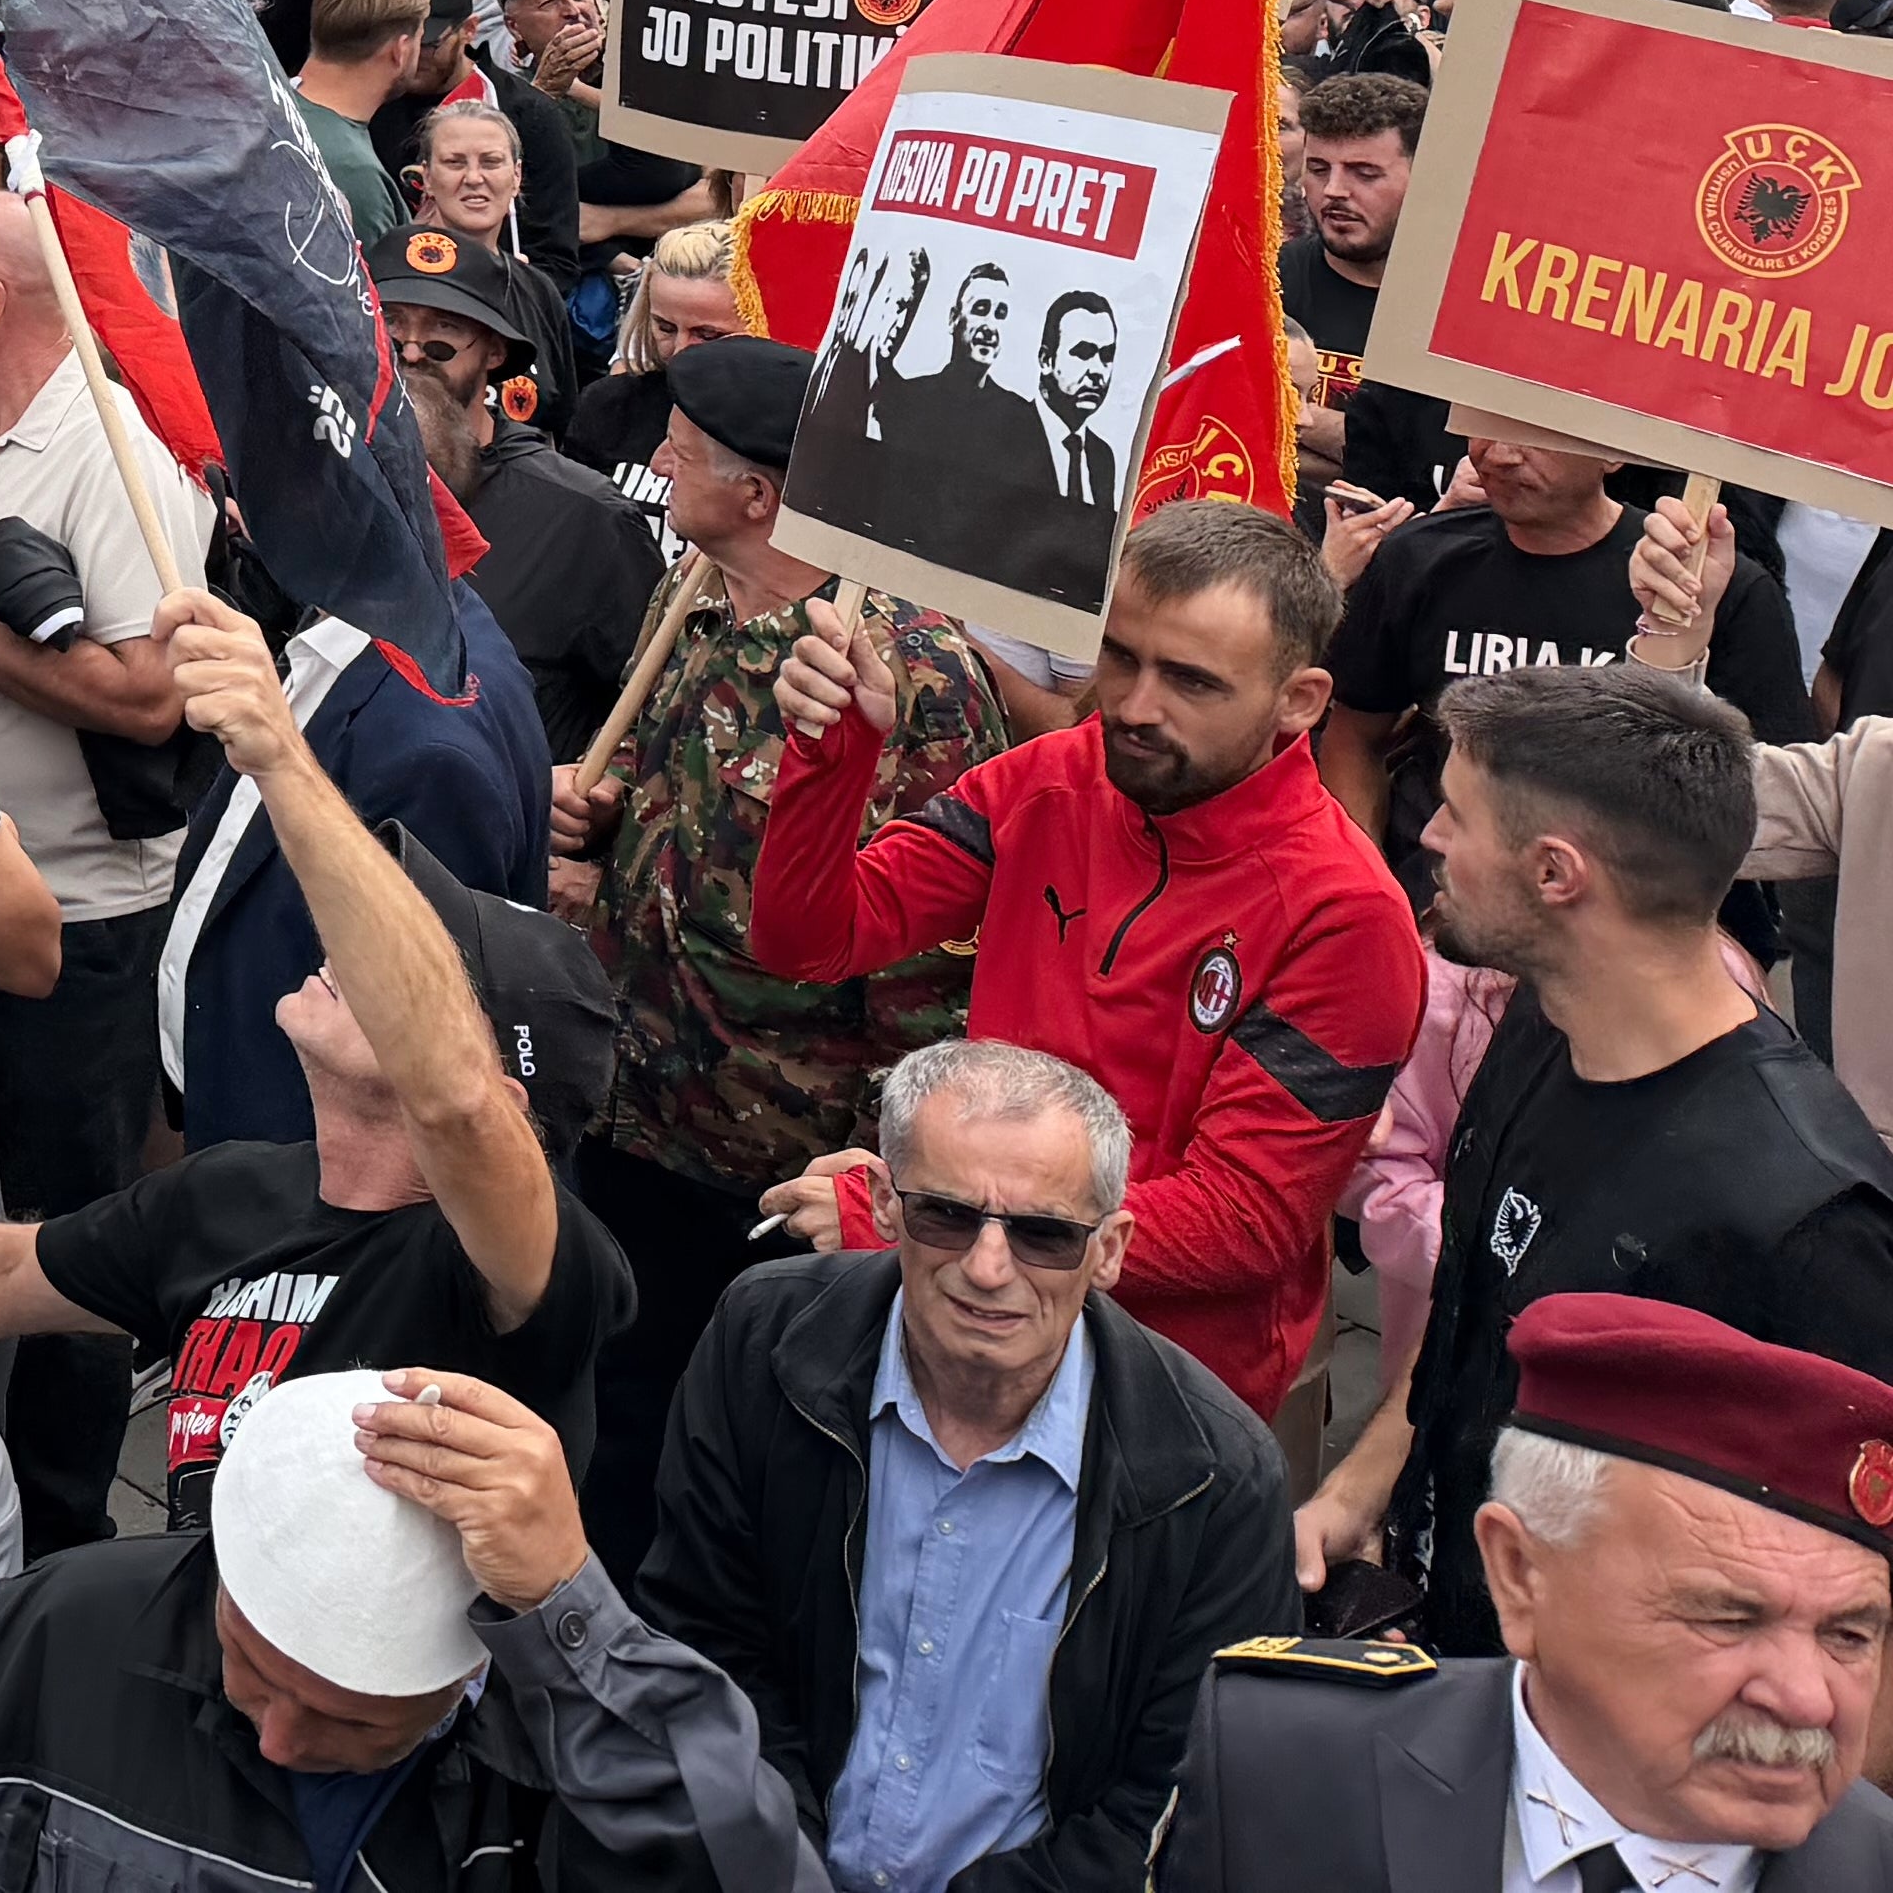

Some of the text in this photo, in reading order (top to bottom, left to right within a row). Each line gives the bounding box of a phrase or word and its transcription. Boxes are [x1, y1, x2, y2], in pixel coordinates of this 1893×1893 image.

[642, 6, 909, 90] JO POLITIK
[1704, 160, 1741, 219] USHTRIA
[1743, 132, 1846, 188] UÇK
[951, 146, 1011, 217] PO
[1006, 155, 1126, 242] PRET
[1479, 231, 1812, 388] KRENARIA
[513, 1024, 536, 1077] POLO
[201, 1271, 340, 1324] HAHIM
